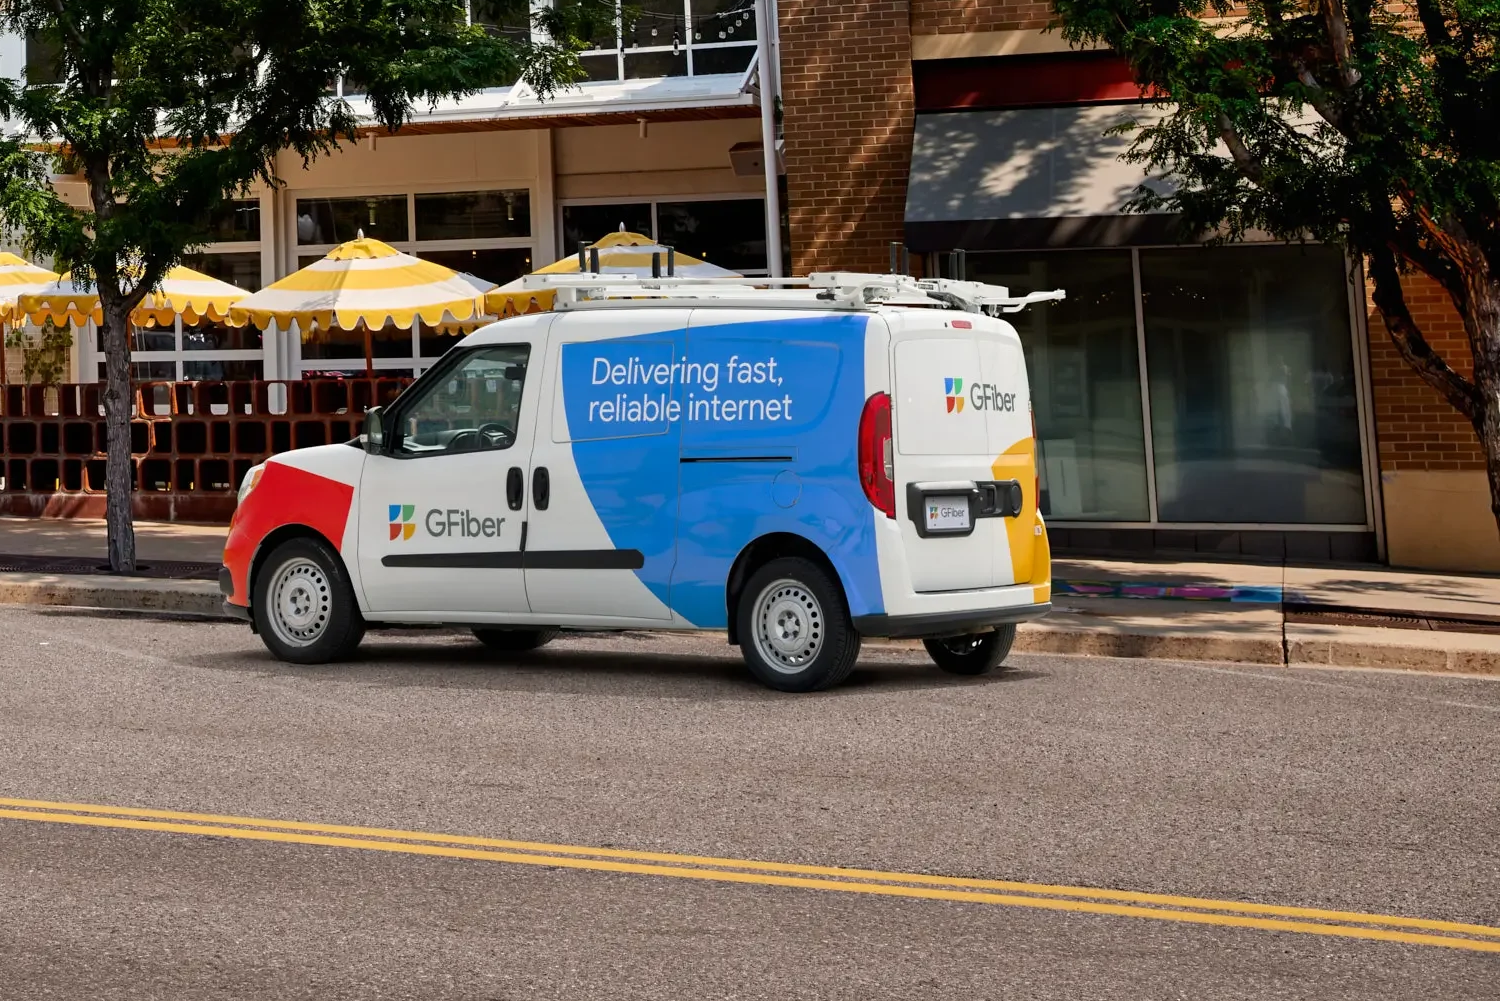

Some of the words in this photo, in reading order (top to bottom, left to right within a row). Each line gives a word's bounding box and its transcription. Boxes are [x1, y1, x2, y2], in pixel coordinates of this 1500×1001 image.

[591, 356, 719, 392] Delivering
[727, 355, 783, 386] fast,
[589, 393, 681, 422] reliable
[688, 392, 793, 421] internet
[970, 382, 1016, 412] GFiber
[425, 508, 506, 538] GFiber
[941, 507, 965, 518] GFiber
